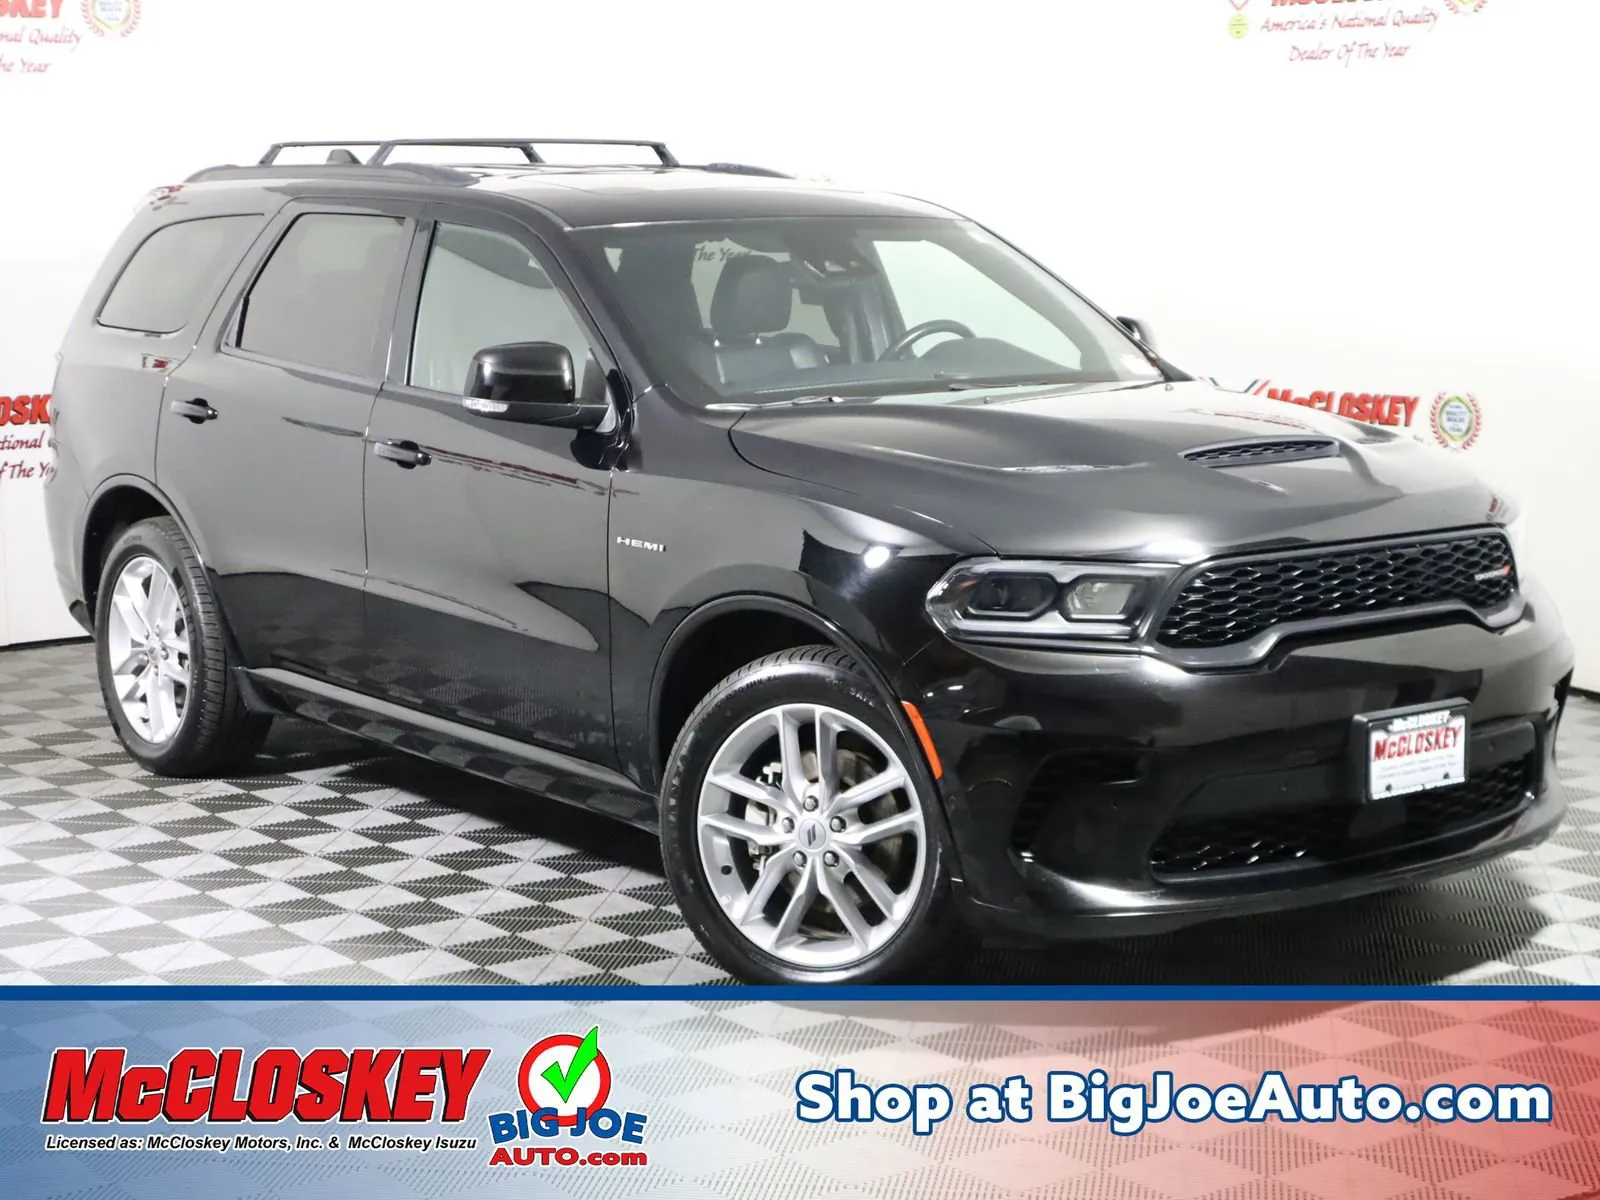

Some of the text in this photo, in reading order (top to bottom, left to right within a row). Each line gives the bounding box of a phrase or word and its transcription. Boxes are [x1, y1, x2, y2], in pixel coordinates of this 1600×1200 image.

[1260, 5, 1440, 33] America's National Quality
[28, 25, 83, 53] Quality
[1289, 42, 1332, 62] Dealer
[1357, 41, 1378, 59] The
[1383, 42, 1411, 59] Year
[1267, 387, 1420, 427] CLOSKEY
[10, 460, 34, 479] The
[617, 536, 667, 552] HEMI
[1373, 725, 1463, 761] McCLOSKEY
